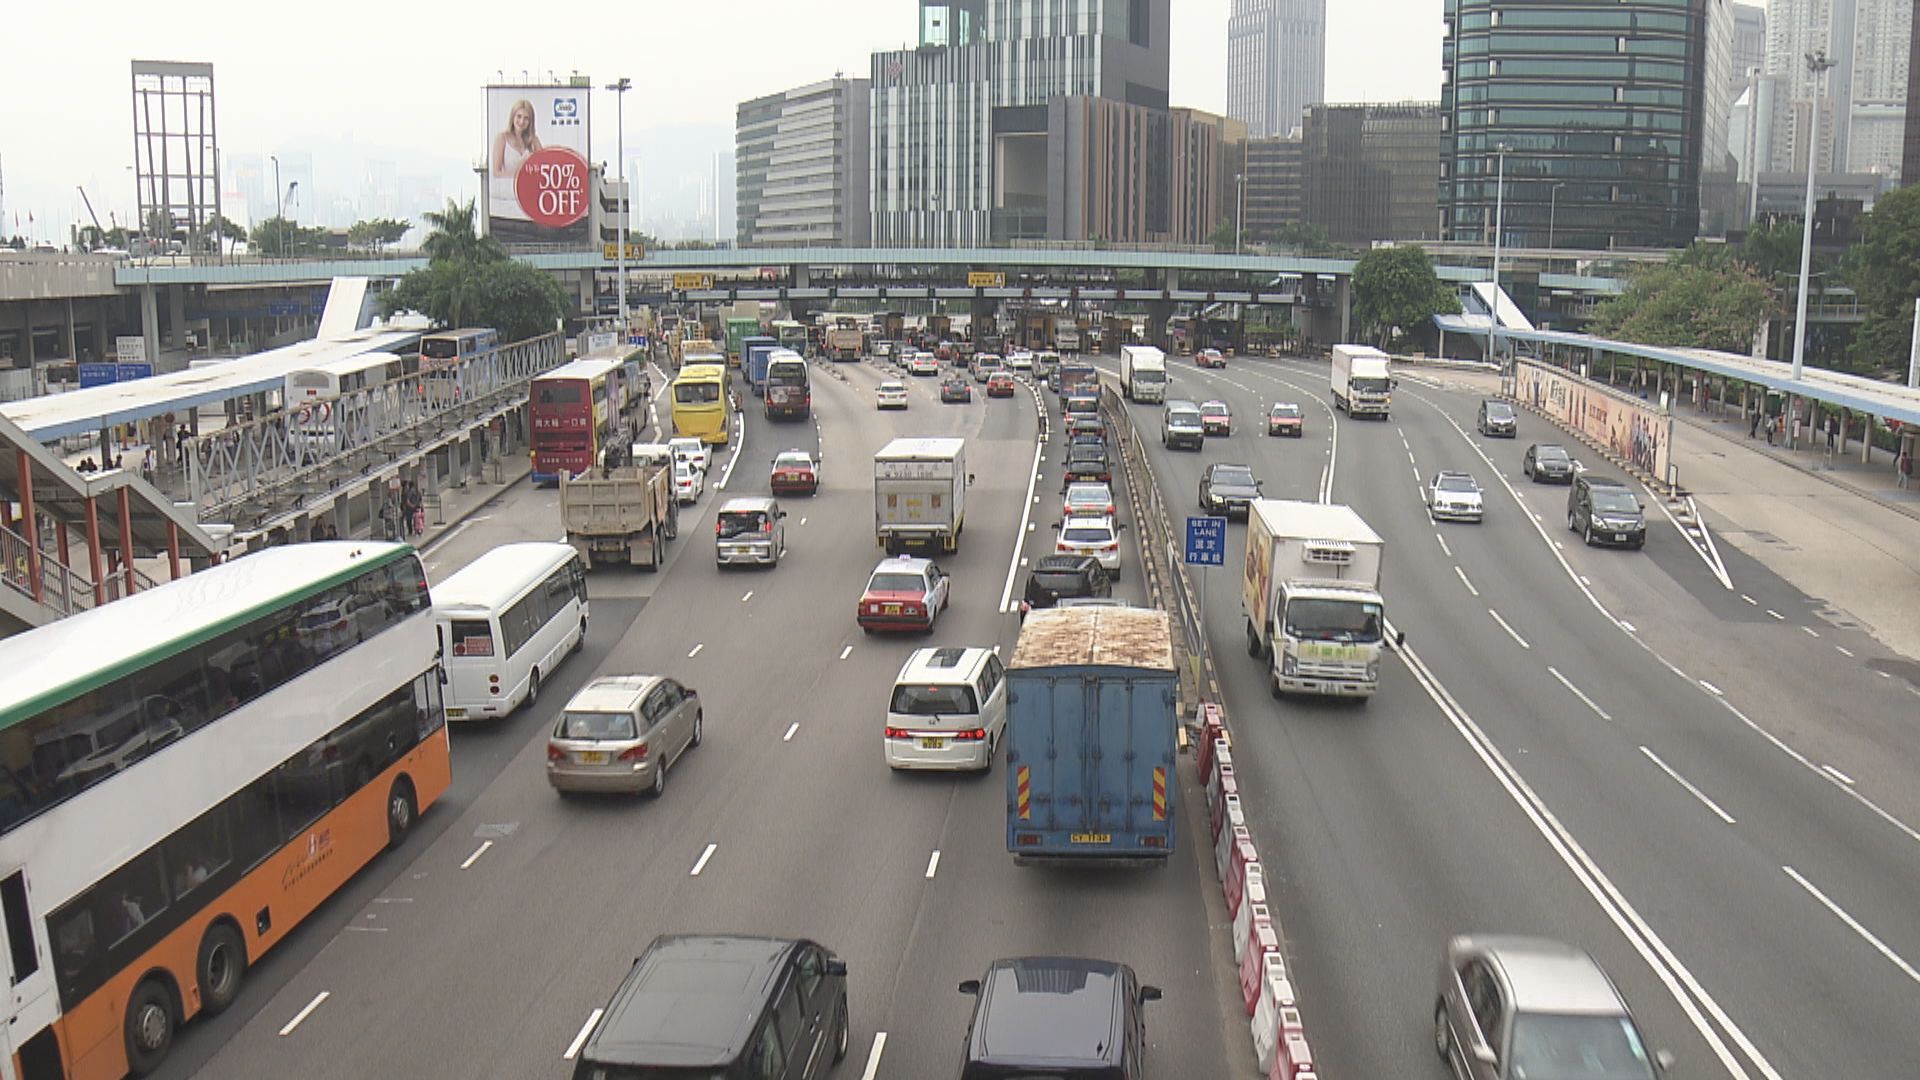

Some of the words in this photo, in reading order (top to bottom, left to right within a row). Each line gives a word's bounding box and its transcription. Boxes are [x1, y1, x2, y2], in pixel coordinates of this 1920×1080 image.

[540, 164, 580, 189] 50%
[633, 247, 640, 258] A
[702, 275, 709, 286] A
[995, 273, 1002, 283] A
[1211, 520, 1221, 528] IN
[1194, 528, 1217, 537] LANE
